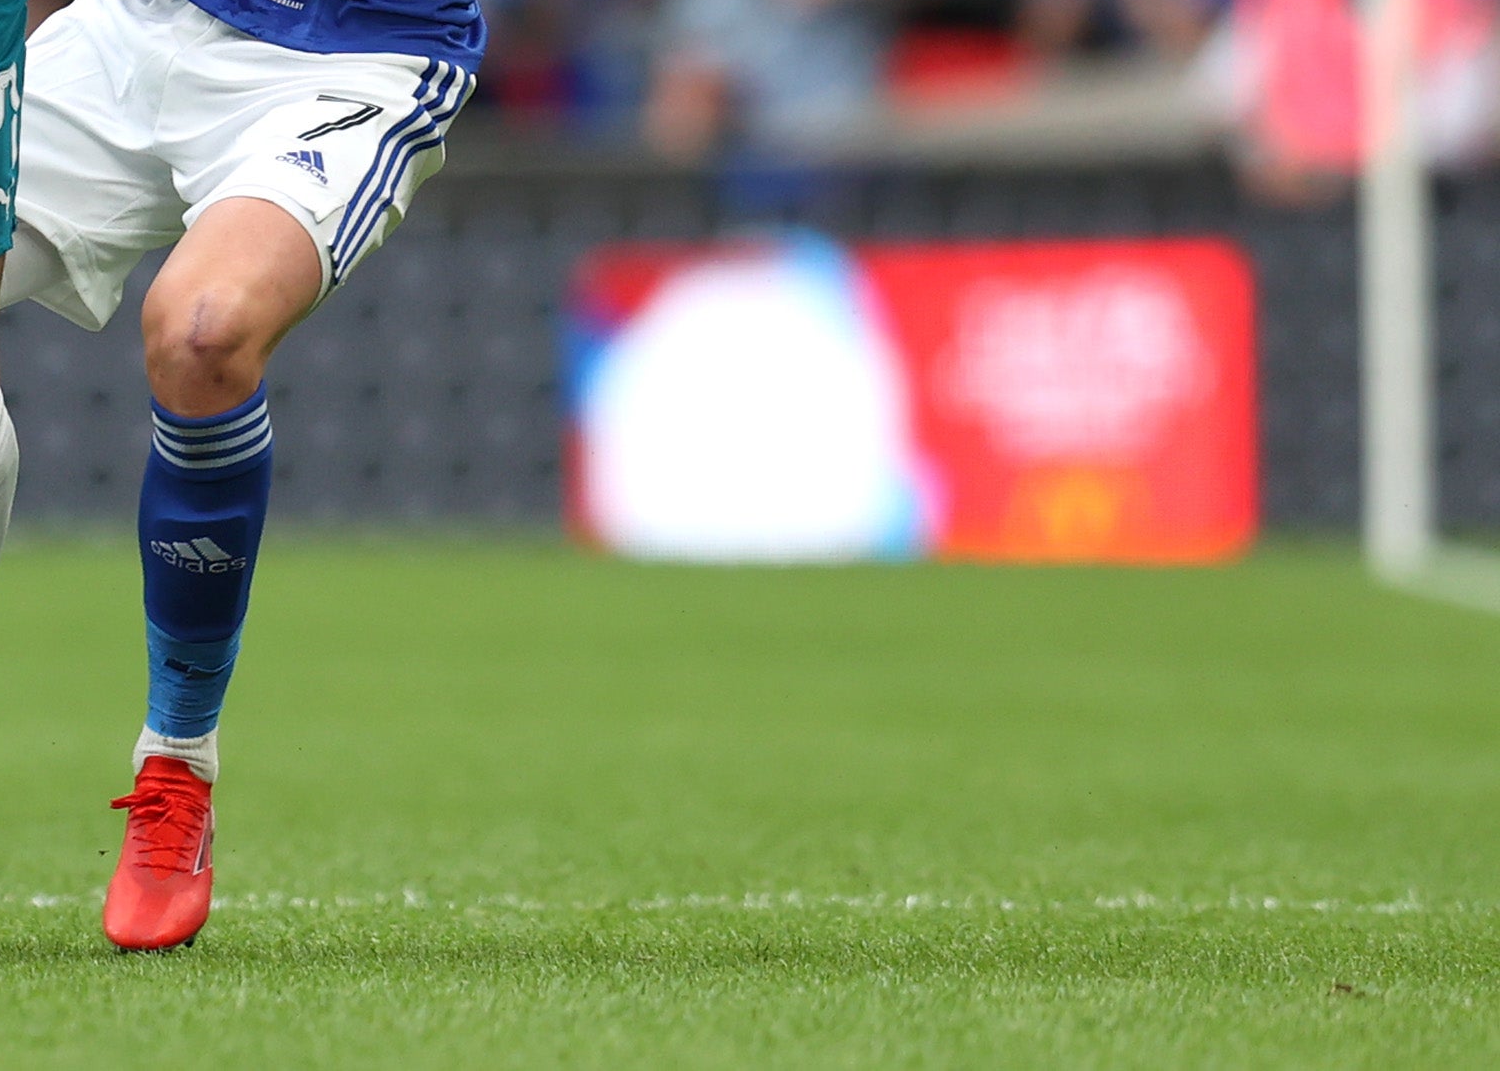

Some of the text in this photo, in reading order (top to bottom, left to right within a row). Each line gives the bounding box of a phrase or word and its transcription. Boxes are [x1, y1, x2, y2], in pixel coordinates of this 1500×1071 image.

[296, 94, 385, 142] 7
[275, 154, 329, 185] adidas
[150, 540, 247, 574] adidas
